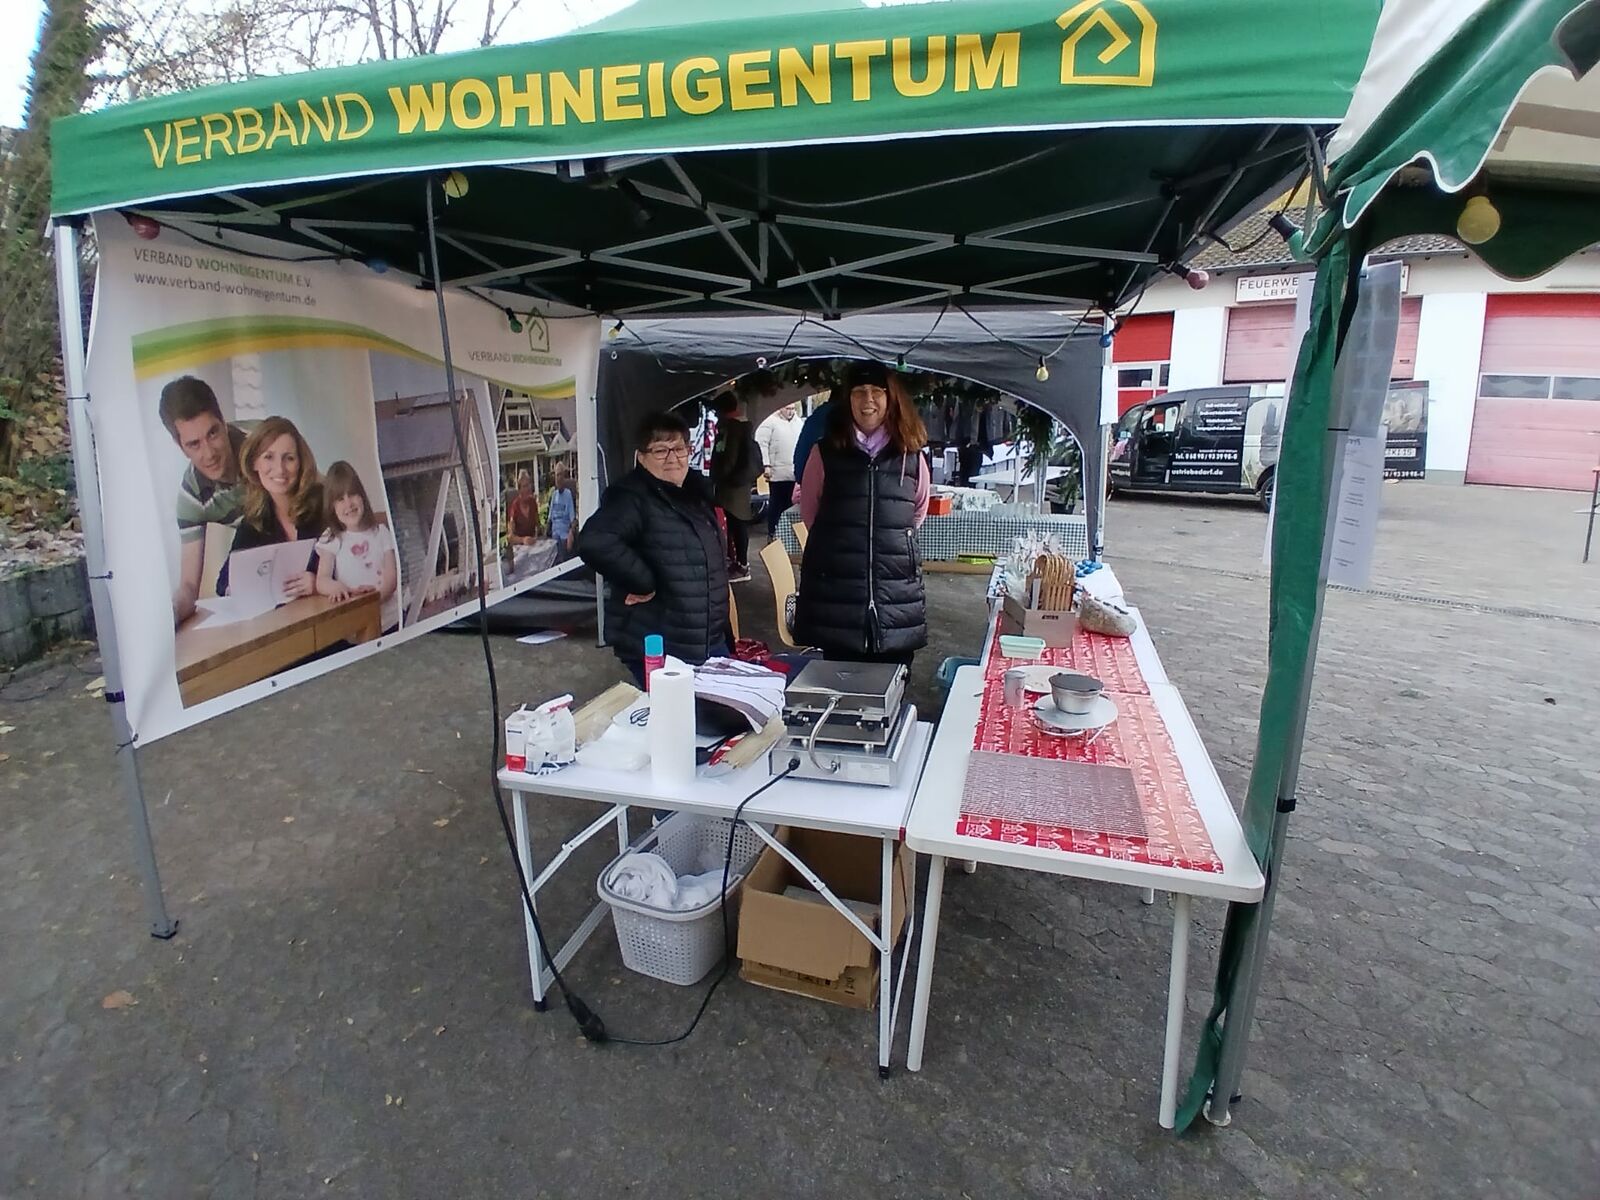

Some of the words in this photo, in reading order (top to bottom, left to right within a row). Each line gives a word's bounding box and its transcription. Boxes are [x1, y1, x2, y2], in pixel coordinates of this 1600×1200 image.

[143, 92, 375, 169] VERBAND
[388, 31, 1022, 135] WOHNEIGENTUM
[134, 247, 193, 268] VERBAND
[195, 257, 293, 284] WOHNEIGENTUM
[134, 272, 316, 306] www.verband-wohneigentum.de
[468, 351, 511, 362] VERBAND
